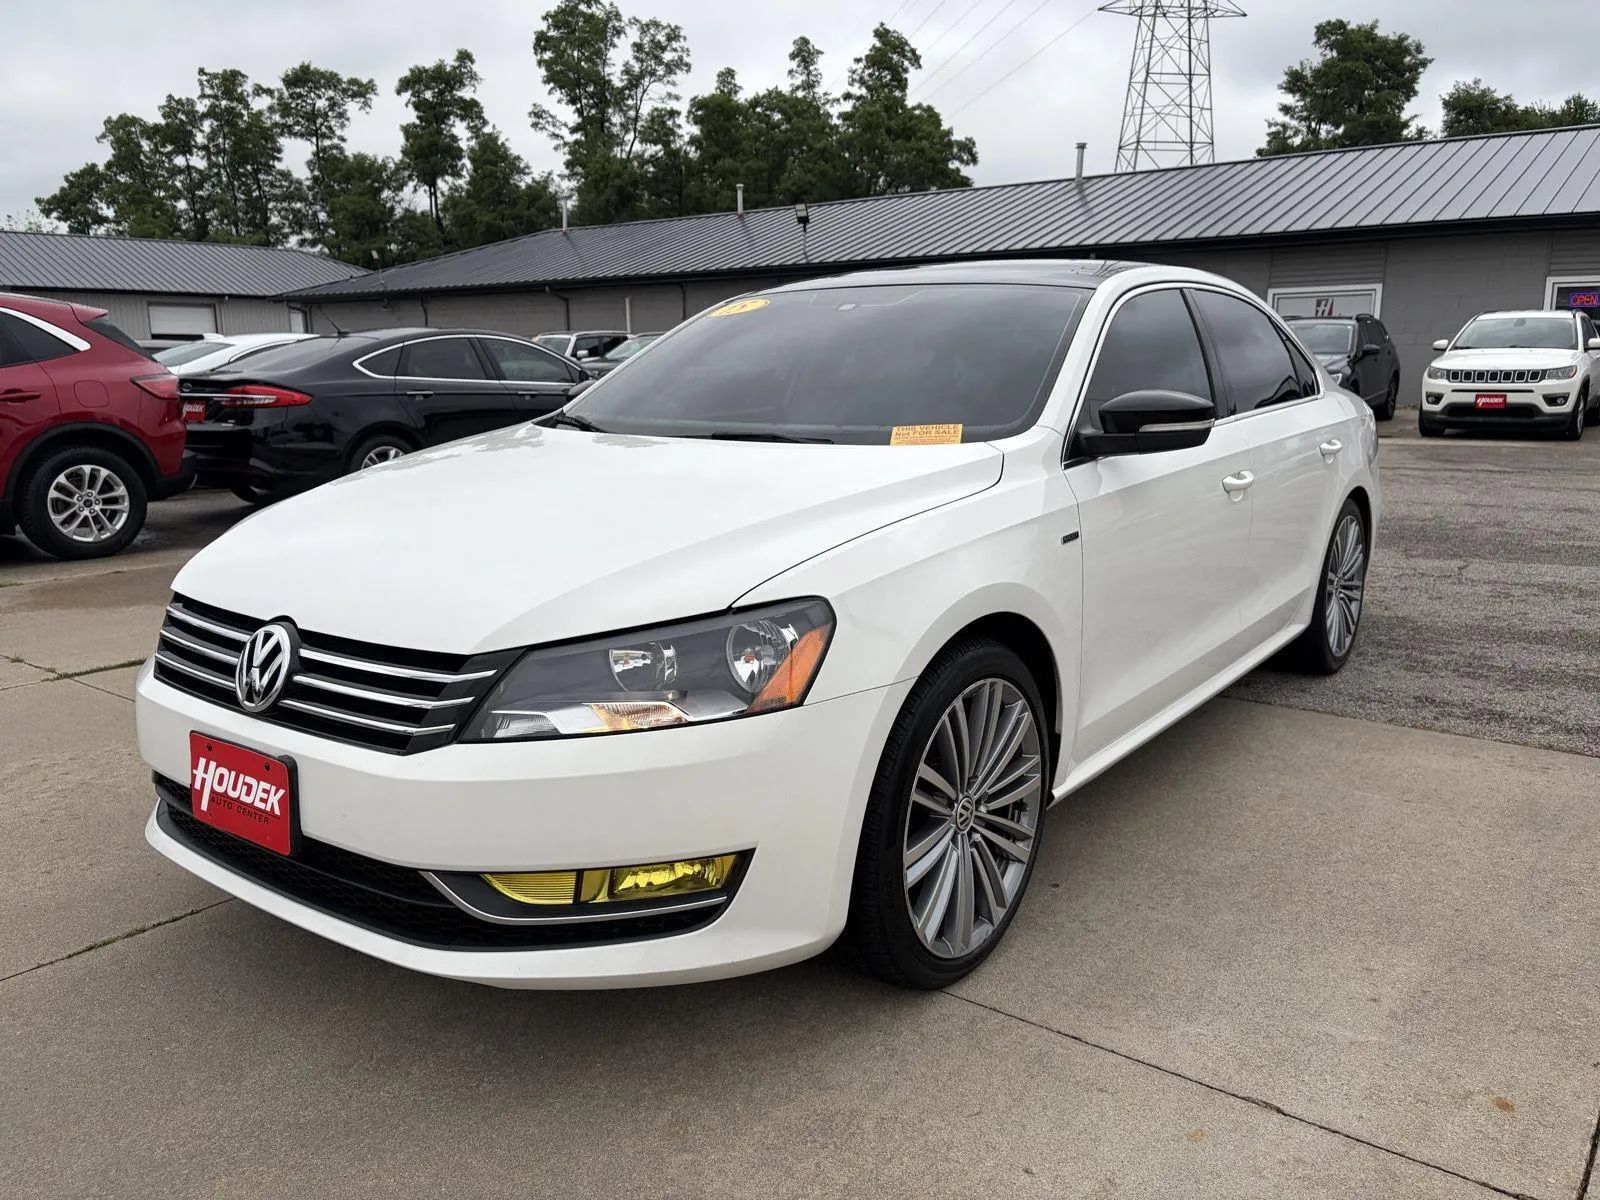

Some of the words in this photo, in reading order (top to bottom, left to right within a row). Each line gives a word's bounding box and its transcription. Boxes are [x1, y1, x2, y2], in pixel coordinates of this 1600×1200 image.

[1571, 294, 1598, 306] OPEN
[192, 756, 286, 815] HOUDEK
[210, 795, 233, 810] AUTO
[236, 805, 270, 825] CENTER
